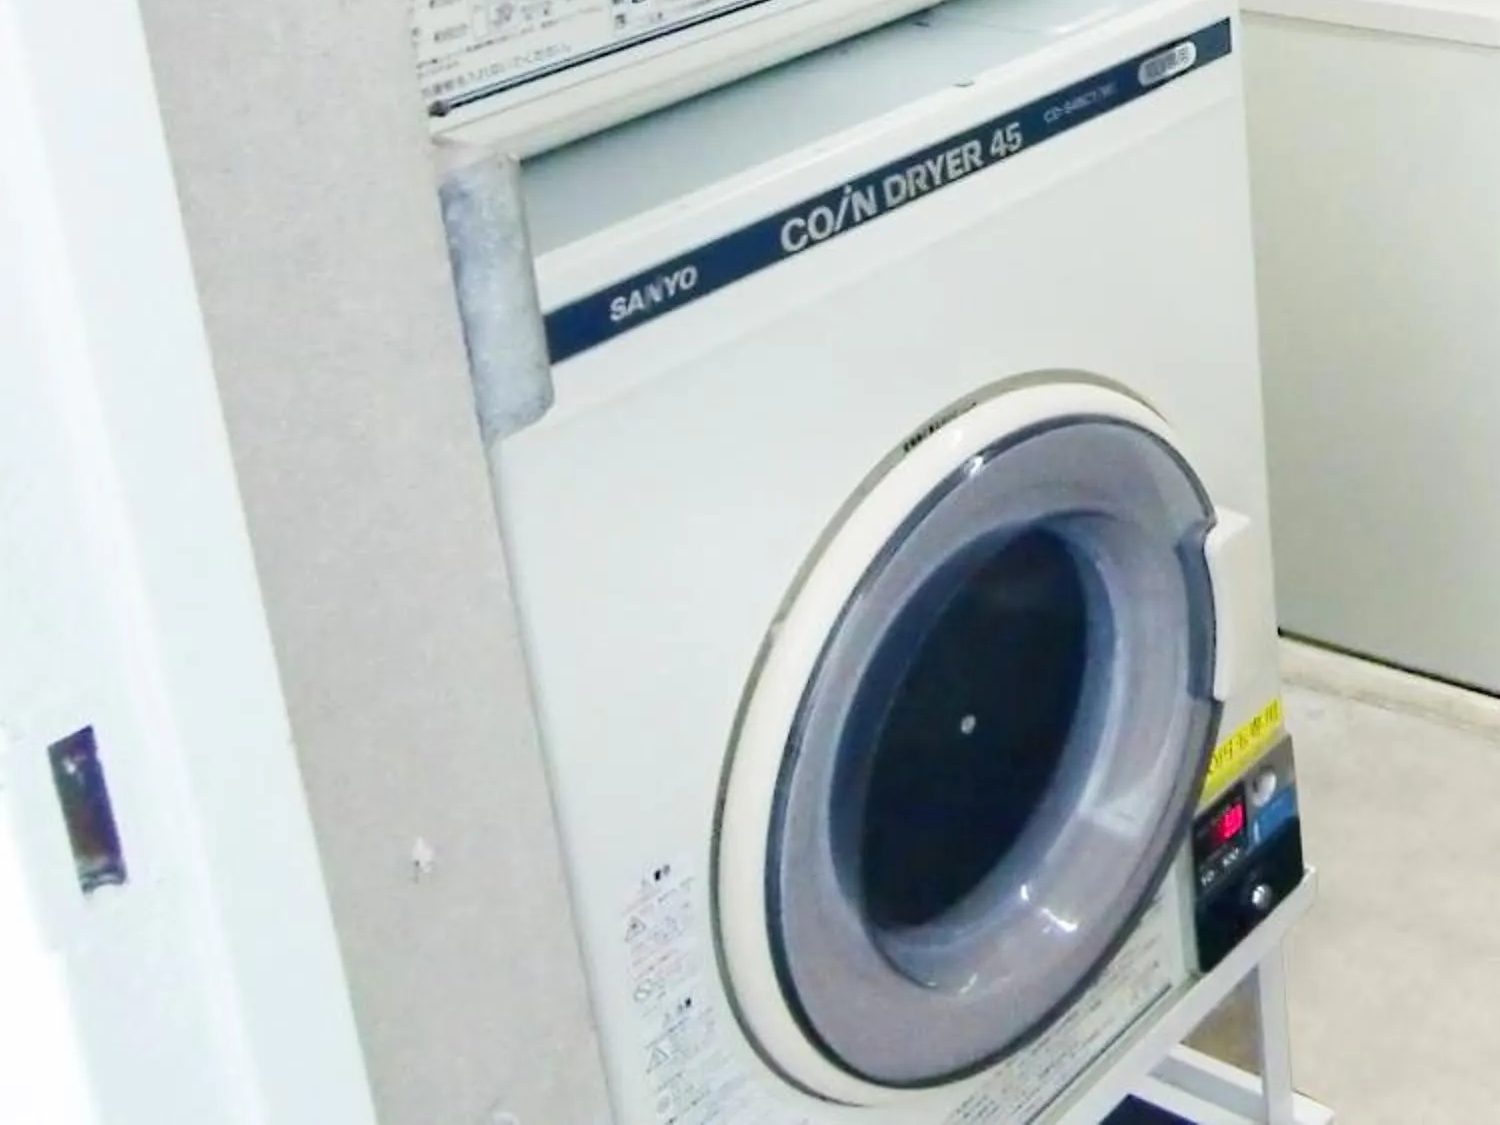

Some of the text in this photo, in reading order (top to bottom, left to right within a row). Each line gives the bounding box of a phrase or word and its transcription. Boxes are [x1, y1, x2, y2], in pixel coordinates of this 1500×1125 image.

[609, 265, 698, 322] SANYO
[780, 184, 878, 252] COIN
[882, 139, 985, 209] DRYER
[989, 122, 1023, 158] 45
